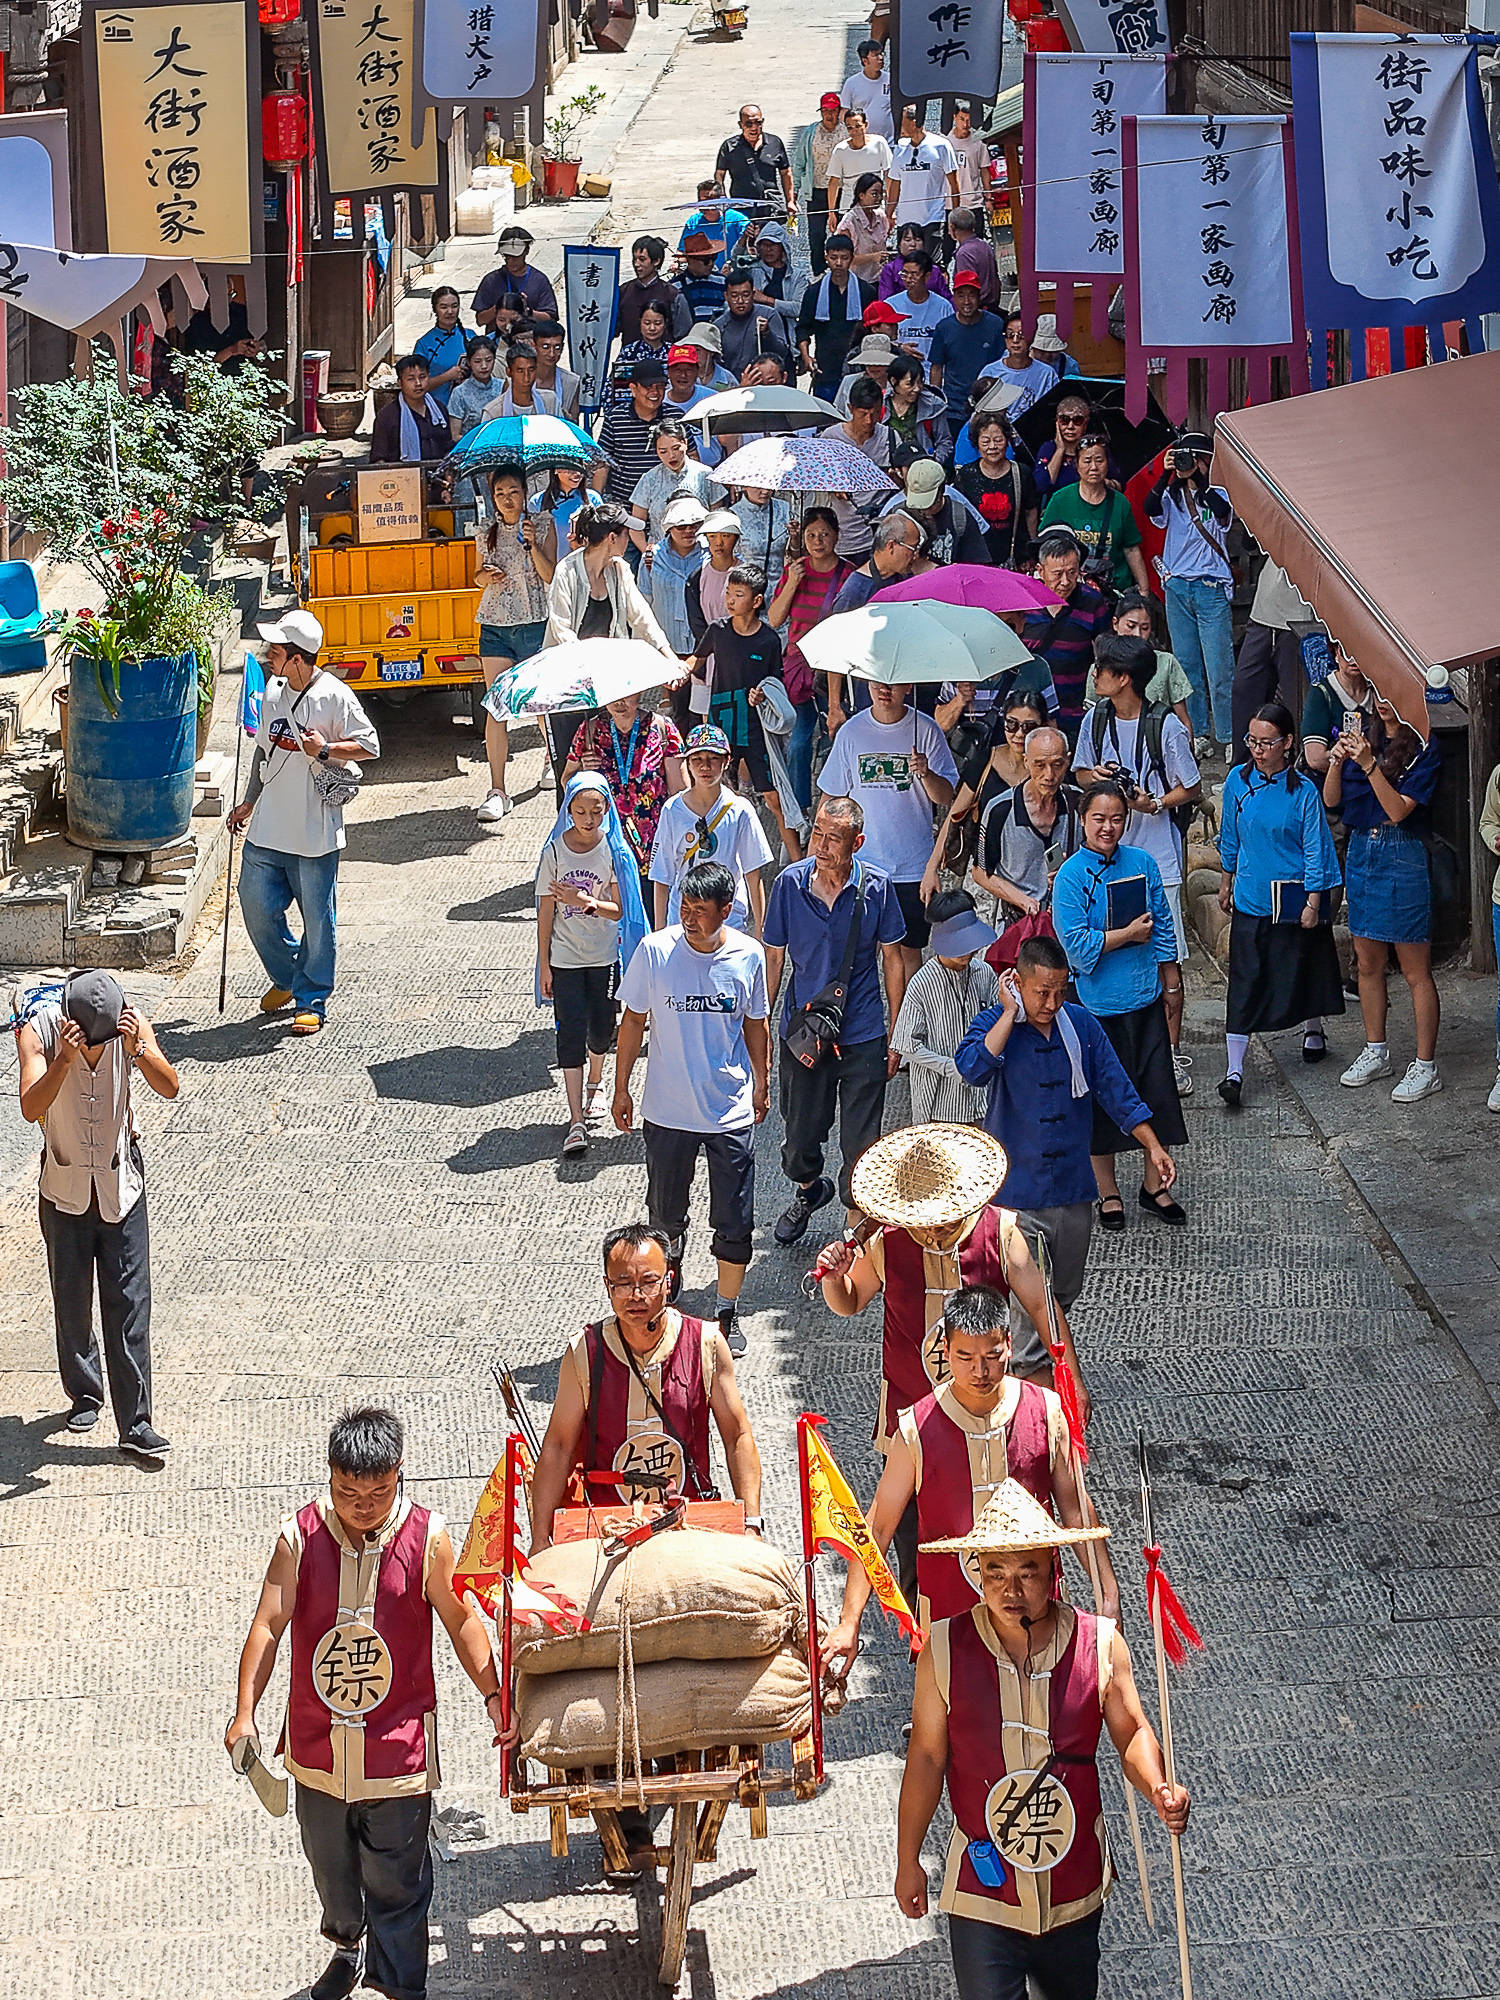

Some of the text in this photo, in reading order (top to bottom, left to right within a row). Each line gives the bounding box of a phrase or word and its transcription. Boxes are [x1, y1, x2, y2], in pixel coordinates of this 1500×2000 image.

[465, 4, 496, 91] 猎犬户
[927, 3, 971, 68] 作坊
[355, 4, 406, 174] 大街酒家
[144, 26, 208, 243] 大街酒家
[1375, 33, 1439, 281] 街品味小吃
[385, 671, 418, 681] 01767
[316, 1630, 384, 1708] 镖
[992, 1778, 1064, 1864] 镖
